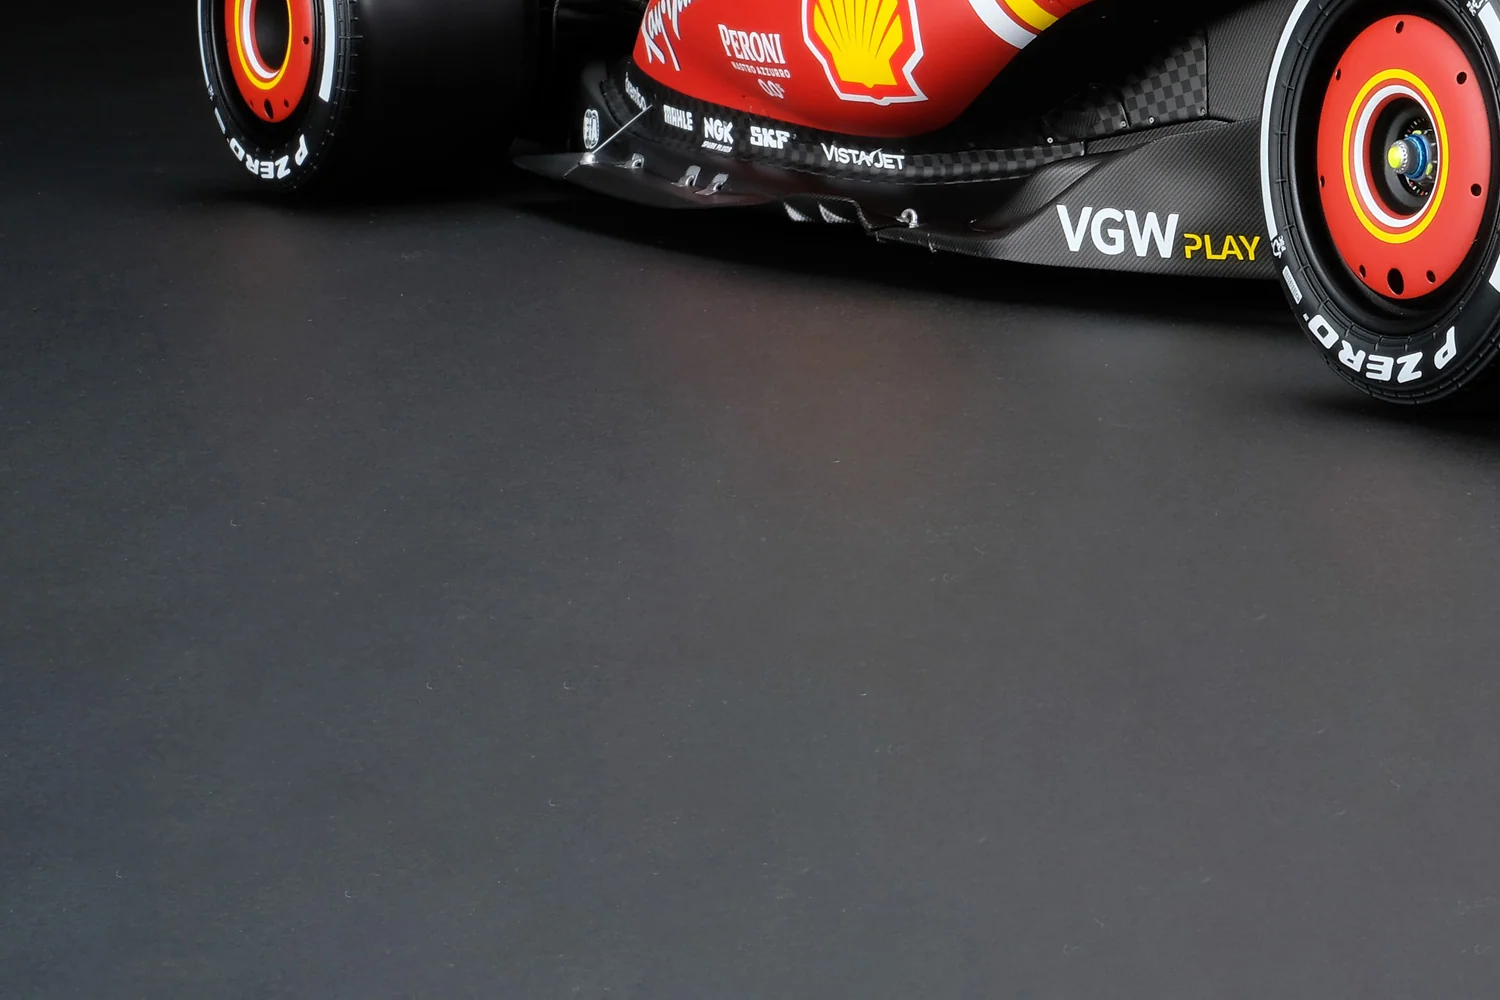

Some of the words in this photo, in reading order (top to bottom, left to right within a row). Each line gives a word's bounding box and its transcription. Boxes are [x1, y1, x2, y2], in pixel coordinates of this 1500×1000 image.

[718, 24, 786, 64] PERONI
[663, 104, 694, 131] MAHLE
[703, 117, 734, 144] NGK
[750, 126, 790, 149] SKF
[229, 137, 291, 179] ZERO
[294, 133, 309, 166] P
[1056, 204, 1179, 259] VGW
[1184, 233, 1260, 261] PLAY
[1308, 314, 1424, 384] ZERO
[1434, 325, 1457, 370] P
